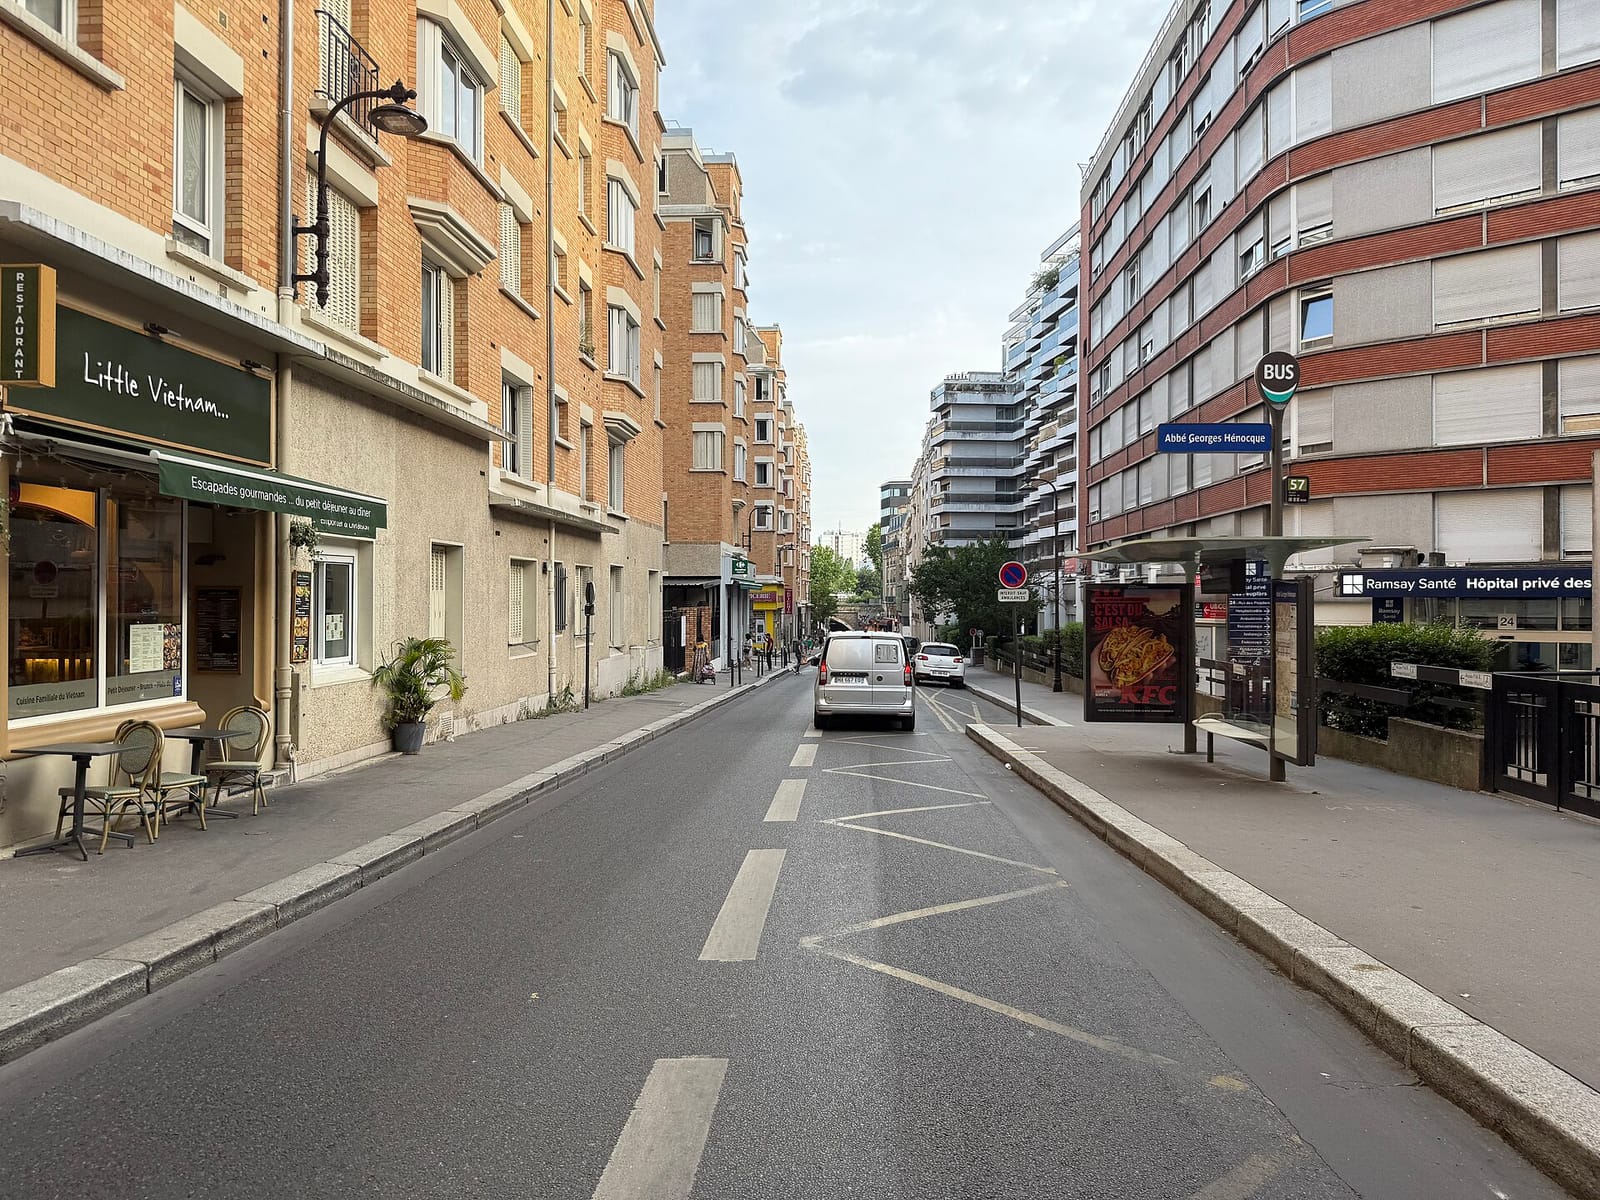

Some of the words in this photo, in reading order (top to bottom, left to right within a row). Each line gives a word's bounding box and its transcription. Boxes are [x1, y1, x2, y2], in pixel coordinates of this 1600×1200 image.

[15, 272, 24, 379] RESTAURANT
[1263, 364, 1294, 380] BUS
[84, 352, 139, 397] Little
[148, 375, 230, 419] Vietnam...
[1164, 433, 1187, 443] Abbé
[1188, 433, 1222, 445] Georges
[1224, 433, 1266, 445] Hénocque
[1290, 479, 1305, 490] 57
[191, 475, 238, 496] Escapades
[239, 487, 287, 504] gourmandes
[295, 497, 305, 508] du
[305, 499, 321, 510] petit
[322, 500, 348, 514] déjeuner
[349, 507, 357, 515] au
[357, 506, 371, 518] dîner
[1366, 578, 1415, 592] Ramsay
[1418, 577, 1457, 590] Santé
[1466, 577, 1518, 592] Hôpital
[1522, 577, 1560, 591] privé
[1564, 577, 1592, 589] des
[1500, 617, 1514, 627] 24
[16, 695, 35, 706] Cuisine
[36, 692, 58, 704] Familiale
[65, 691, 85, 701] Vietnam
[1119, 685, 1177, 705] KFC
